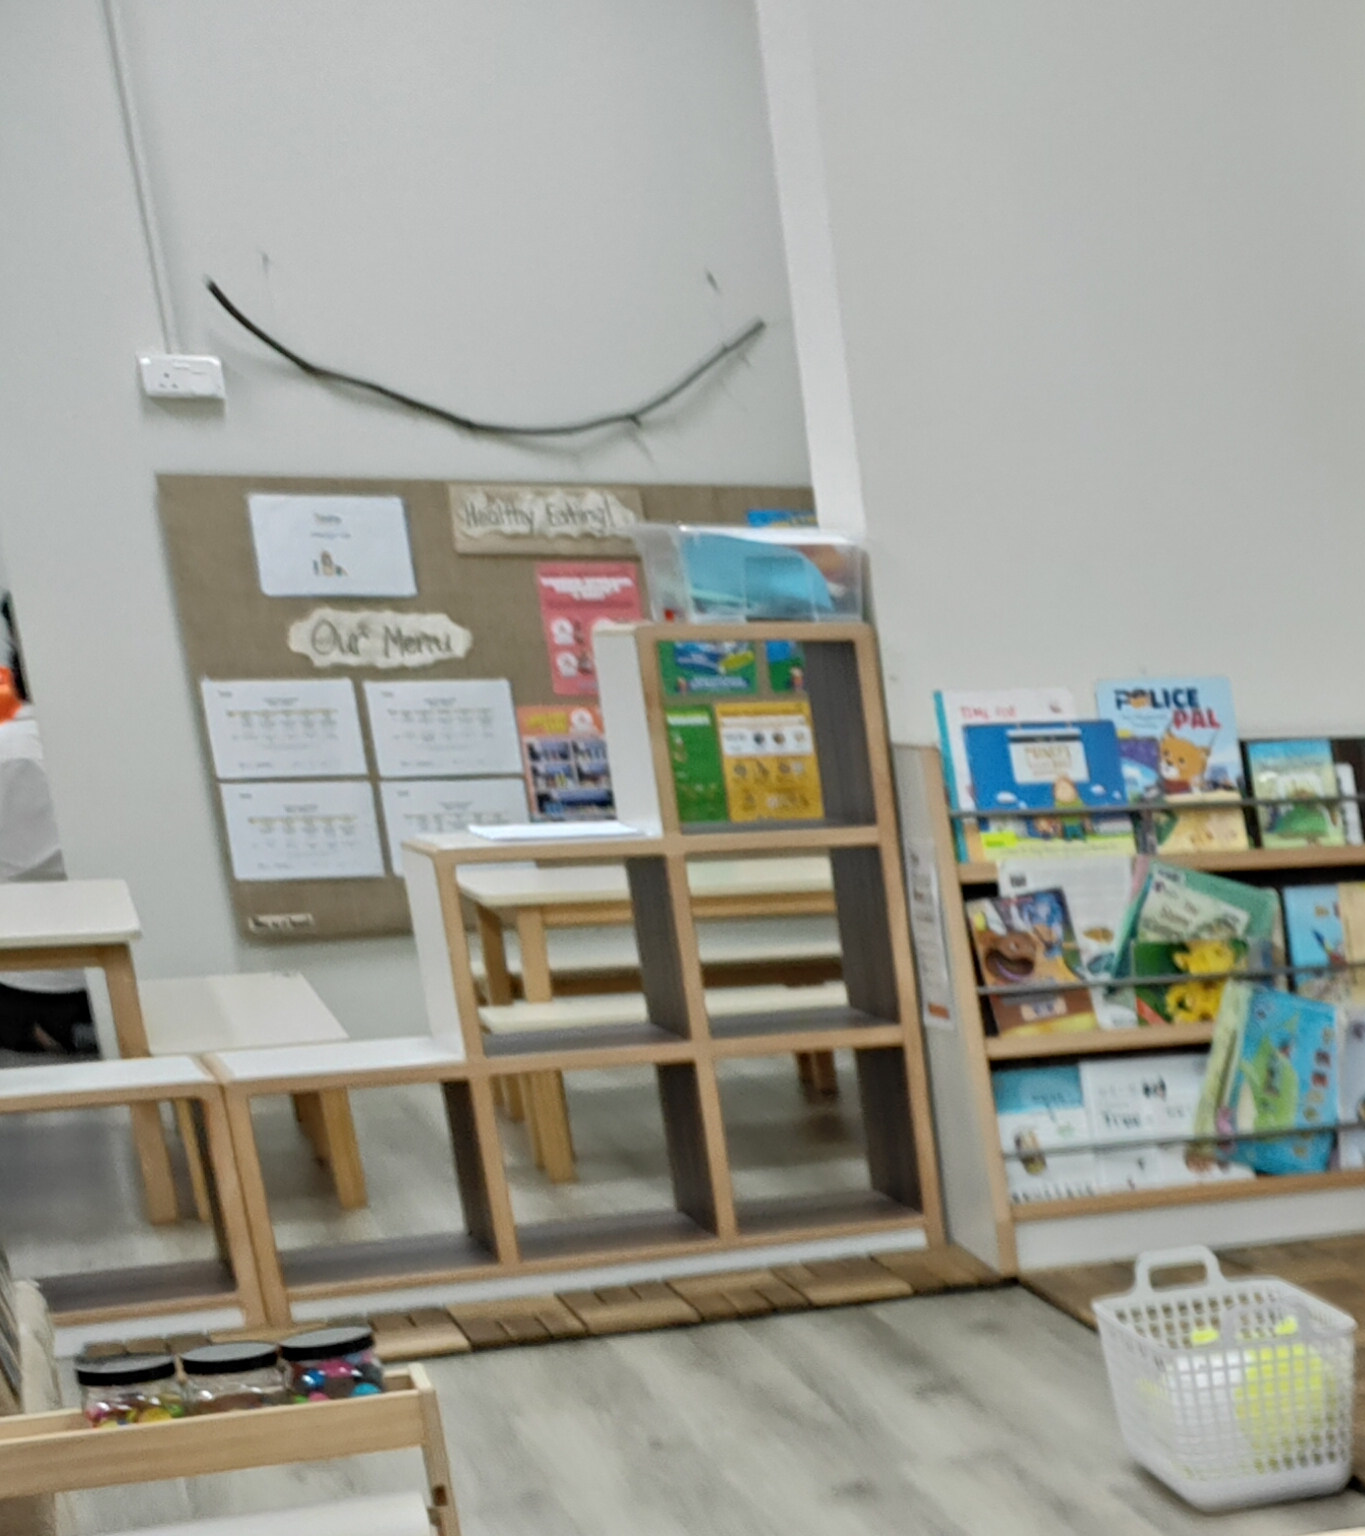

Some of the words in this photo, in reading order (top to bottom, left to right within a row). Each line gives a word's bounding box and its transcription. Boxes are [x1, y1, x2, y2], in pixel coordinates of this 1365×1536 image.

[464, 498, 535, 536] Healthy
[310, 618, 371, 657] Our
[383, 623, 454, 659] Menu
[1114, 687, 1201, 711] POLICE
[1172, 707, 1223, 730] PAL
